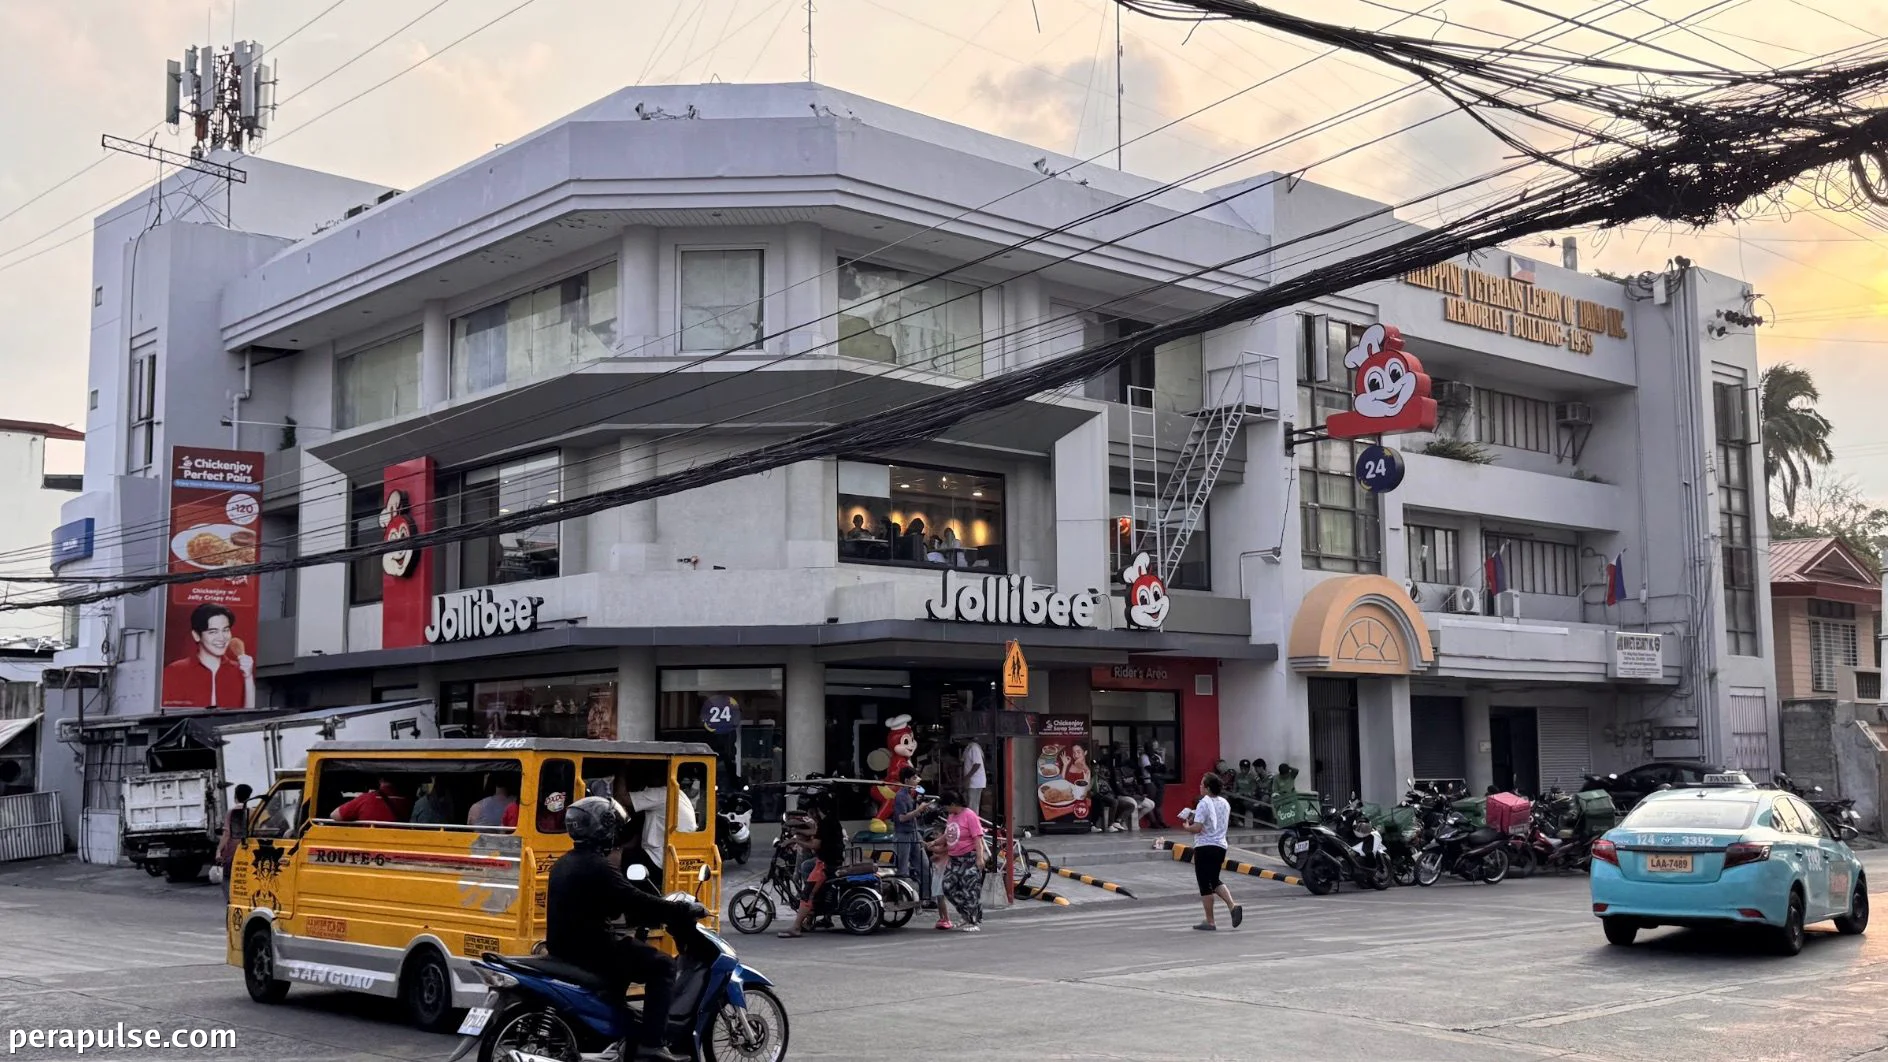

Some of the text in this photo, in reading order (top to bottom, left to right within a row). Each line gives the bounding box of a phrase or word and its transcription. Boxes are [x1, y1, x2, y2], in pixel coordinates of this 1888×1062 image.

[1402, 262, 1464, 297] HILIPPINE
[1467, 268, 1523, 312] VETERANS
[1527, 286, 1561, 321] LEGION
[1562, 296, 1575, 325] OF
[1444, 297, 1508, 335] MEMORIAL
[194, 458, 253, 474] Chickenjoy
[1365, 458, 1387, 480] 24
[183, 469, 252, 483] Perfect Pairs
[926, 569, 1094, 628] Jollibee
[425, 589, 535, 643] Jollibee
[1114, 665, 1168, 680] Rider's Area
[709, 706, 731, 723] 24
[1277, 809, 1296, 821] Grab
[1681, 835, 1714, 847] 3392
[1650, 859, 1688, 869] LAA-7489
